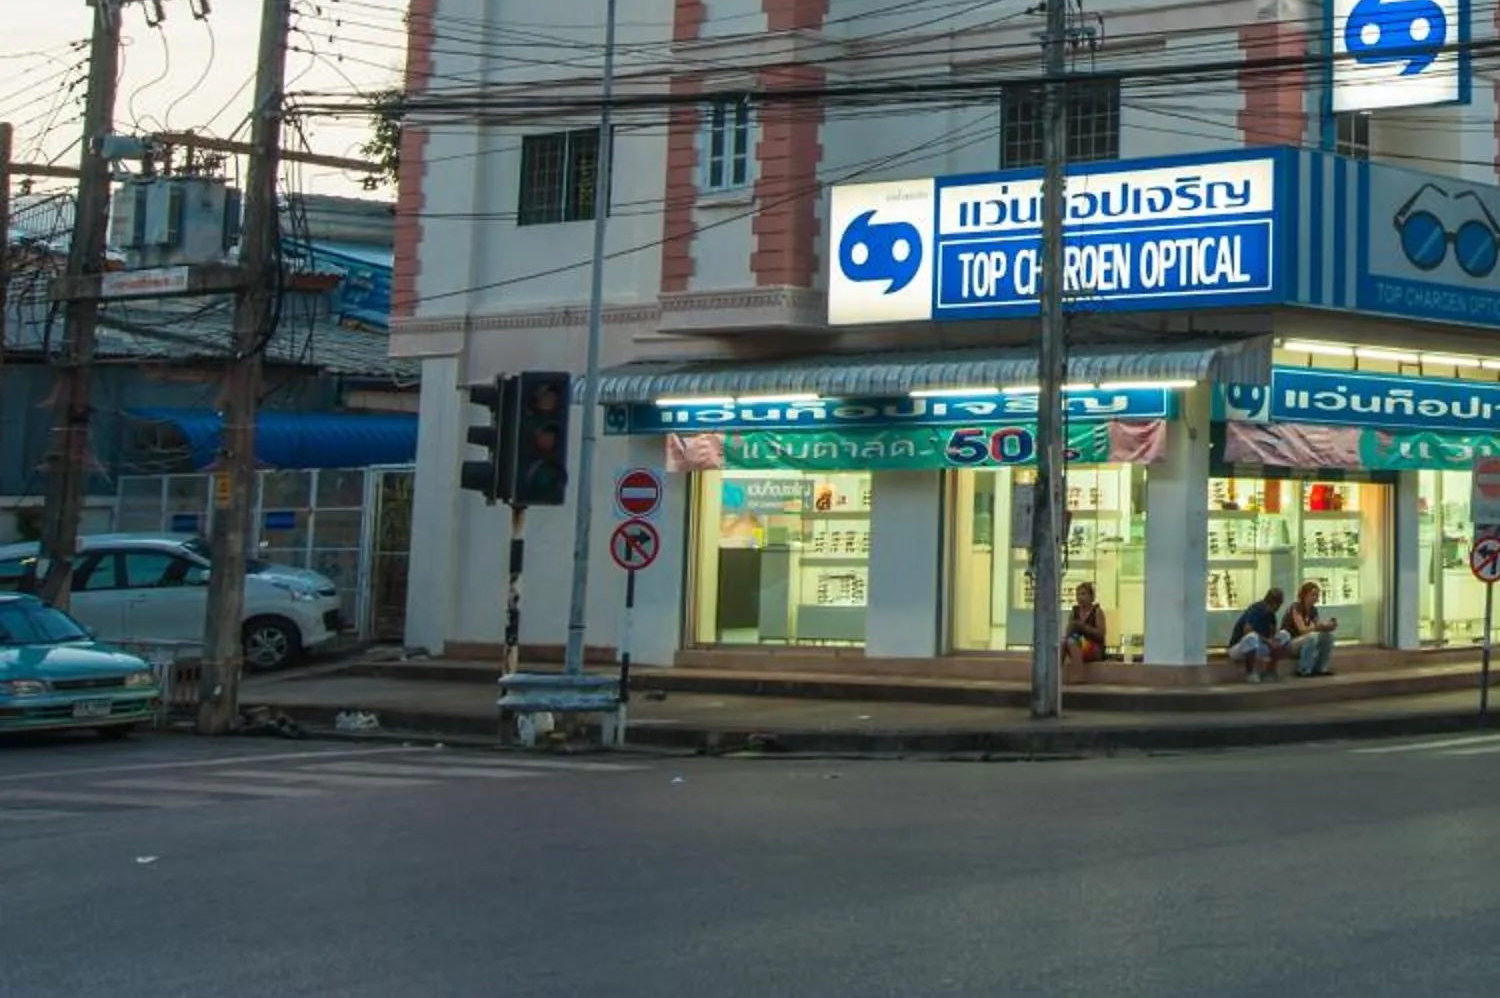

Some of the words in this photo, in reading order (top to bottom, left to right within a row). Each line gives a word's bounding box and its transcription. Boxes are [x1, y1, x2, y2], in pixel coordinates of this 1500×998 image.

[958, 251, 1007, 299] TOP
[1013, 242, 1131, 296] CHROEN
[1139, 234, 1252, 288] OPTICAL
